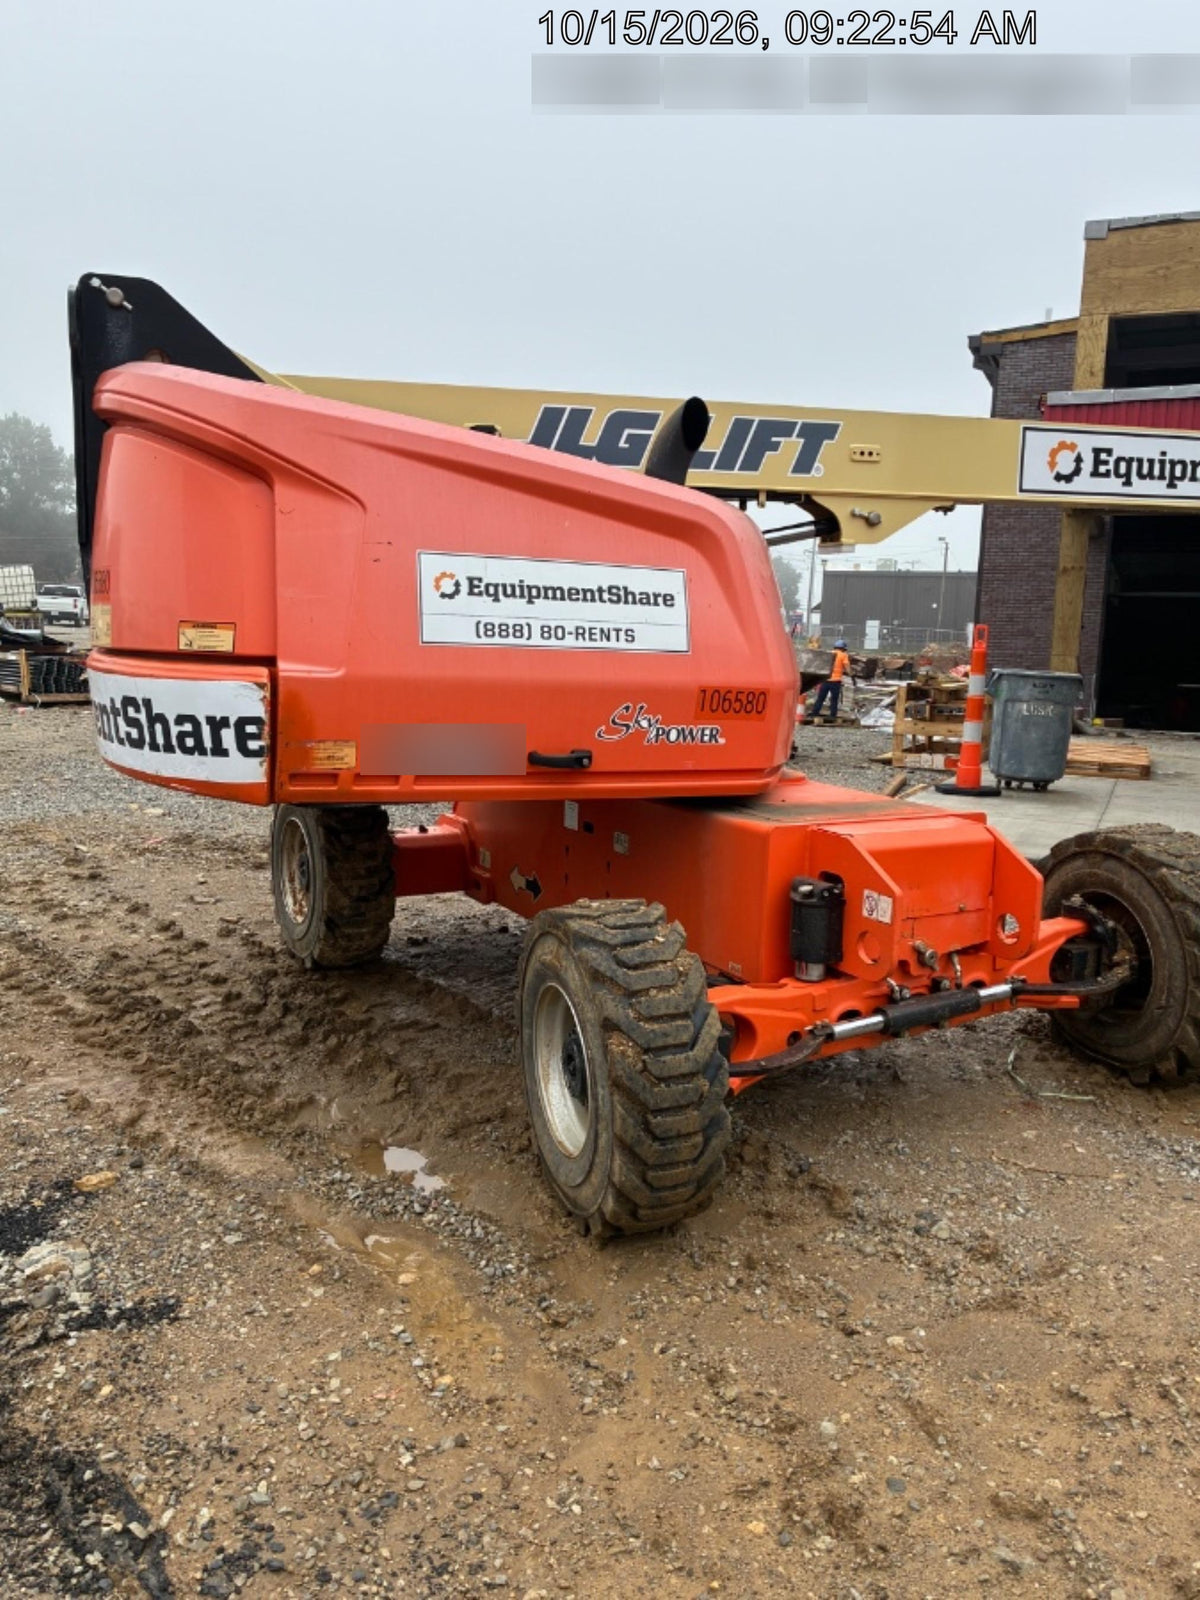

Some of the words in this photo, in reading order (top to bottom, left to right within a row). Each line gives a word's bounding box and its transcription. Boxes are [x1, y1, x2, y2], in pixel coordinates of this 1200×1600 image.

[466, 576, 675, 607] EquipmentShare
[475, 620, 532, 641] (888)
[540, 625, 636, 643] 80-RENTS
[699, 689, 768, 715] 106580
